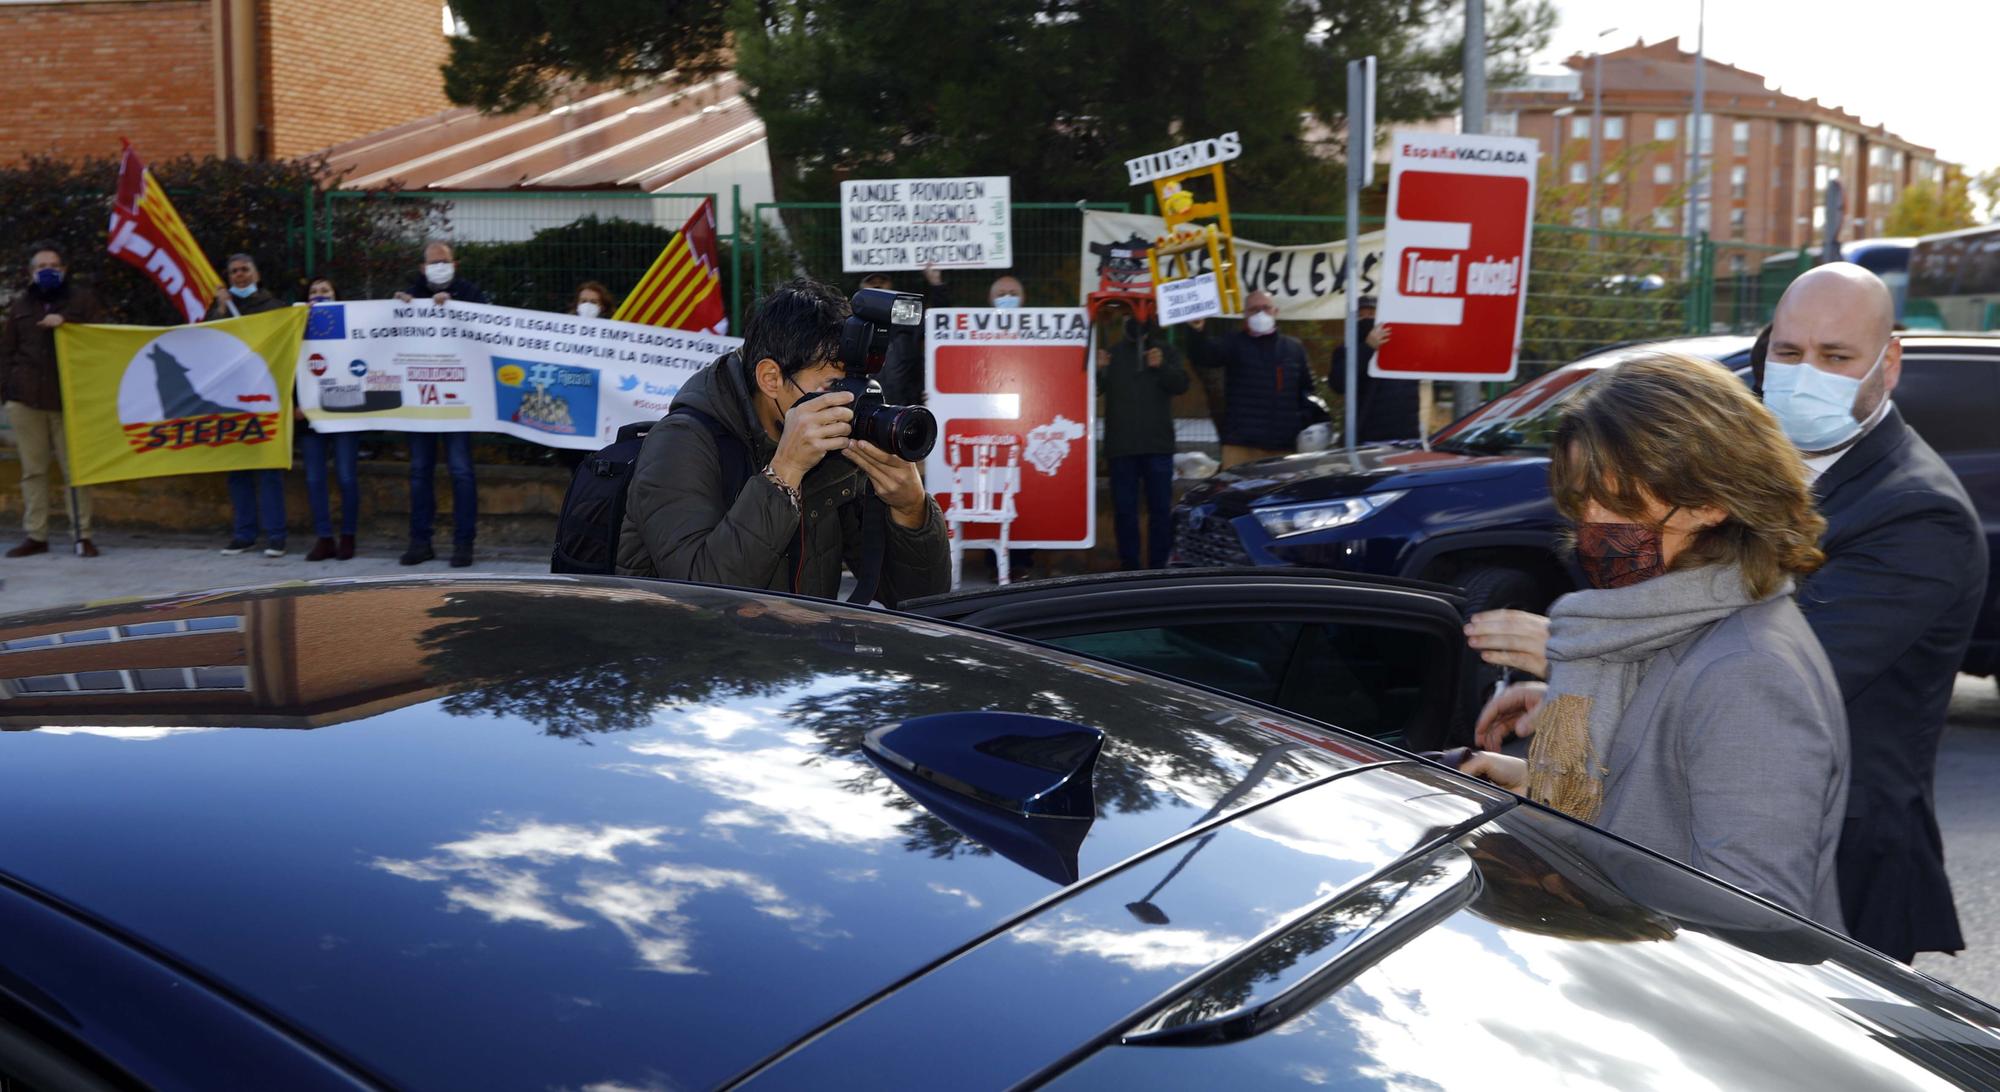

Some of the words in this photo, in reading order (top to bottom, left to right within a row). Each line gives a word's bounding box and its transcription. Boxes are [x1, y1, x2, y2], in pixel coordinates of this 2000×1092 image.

[850, 204, 908, 222] NUESTRA
[851, 227, 868, 243] NO
[942, 226, 970, 242] CON
[851, 248, 908, 264] NUESTRA
[393, 308, 414, 319] NO
[449, 309, 511, 327] DESPIDOS
[515, 318, 577, 335] ILEGALES
[580, 325, 597, 337] DE
[600, 328, 682, 349] EMPLEADOS
[935, 313, 1086, 330] REVUELTA
[351, 328, 366, 339] EL
[369, 326, 436, 339] GOBIERNO
[440, 326, 457, 338] DE
[517, 337, 550, 351] DEBE
[553, 341, 616, 359] CUMPLIR
[620, 350, 637, 362] LA
[935, 330, 949, 340] de
[953, 330, 965, 340] la
[417, 384, 440, 405] YA
[146, 416, 265, 448] STEPA
